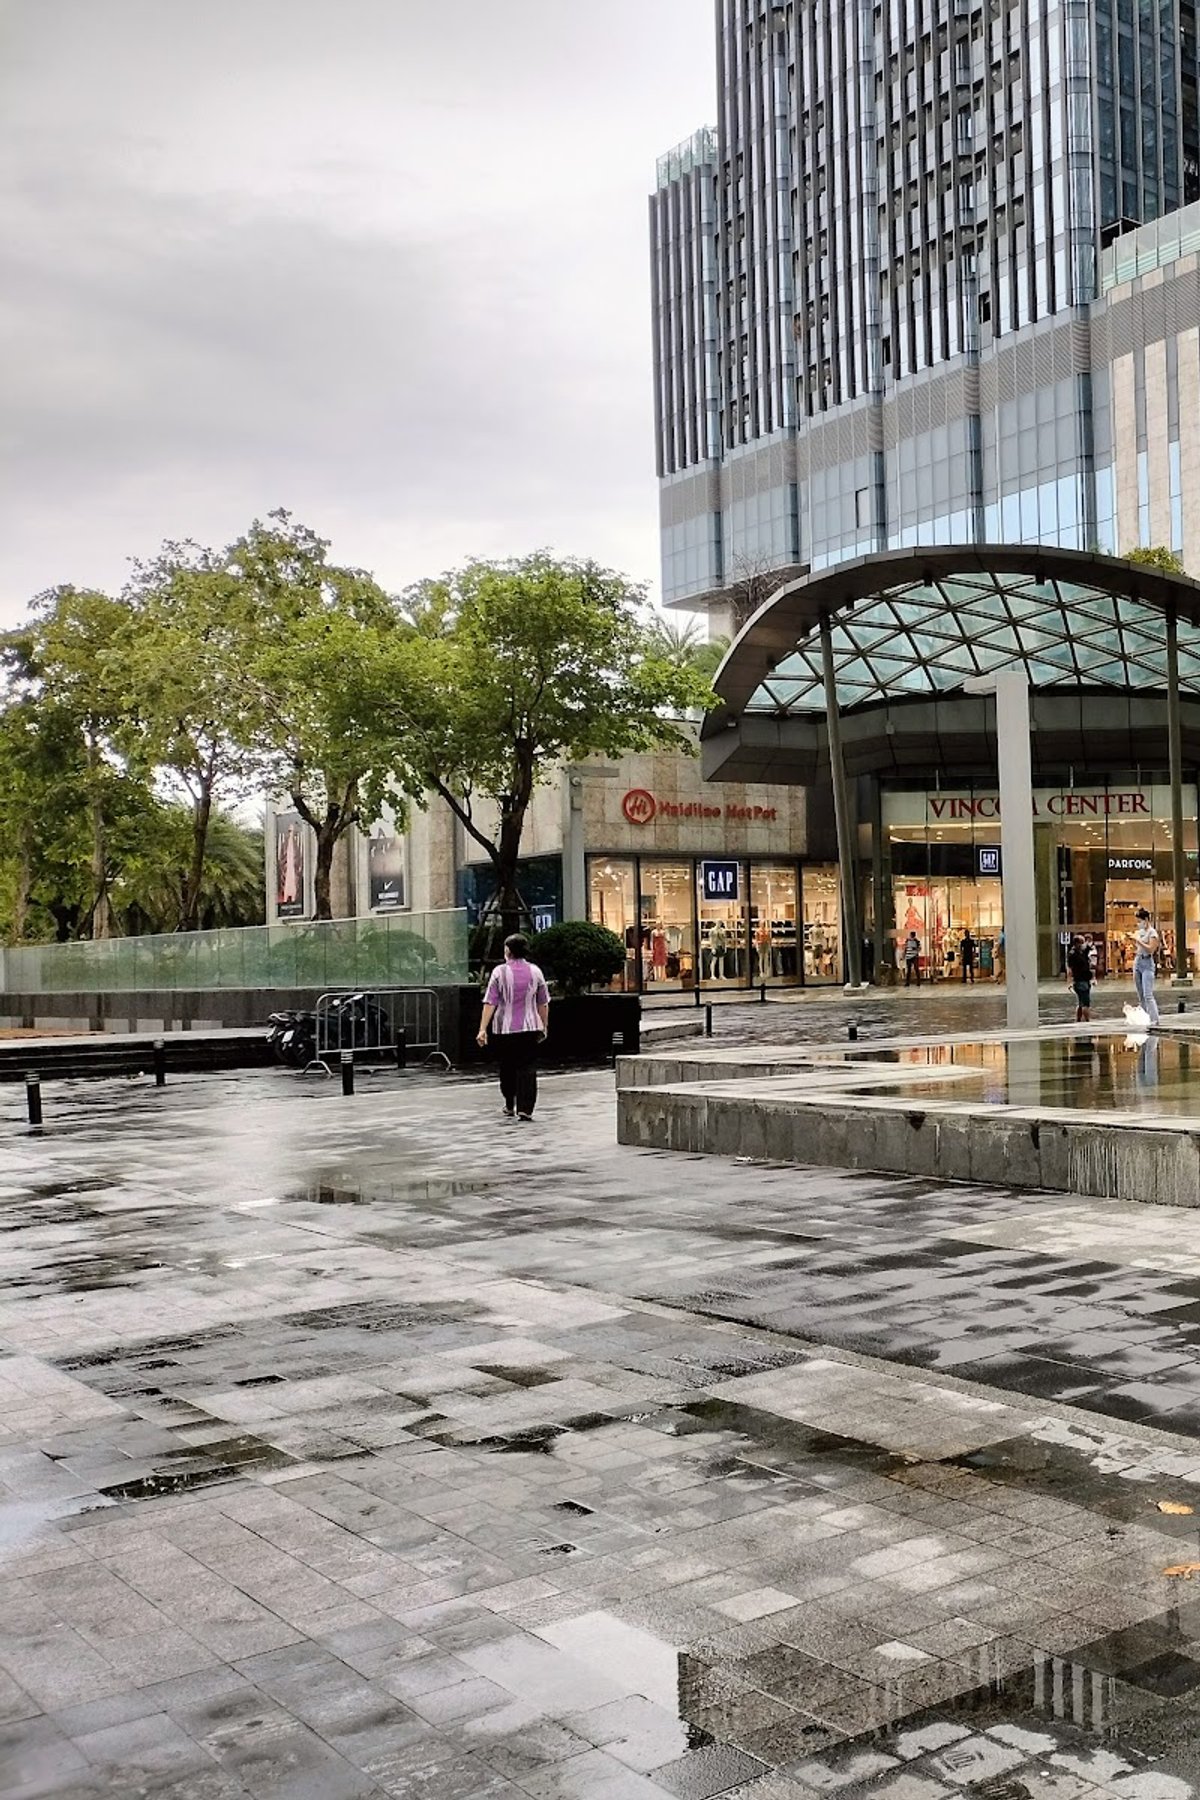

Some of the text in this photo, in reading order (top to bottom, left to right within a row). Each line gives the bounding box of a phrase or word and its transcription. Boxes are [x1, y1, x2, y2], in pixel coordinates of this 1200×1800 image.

[930, 793, 1150, 819] VINC CENTER
[708, 871, 734, 892] GAP
